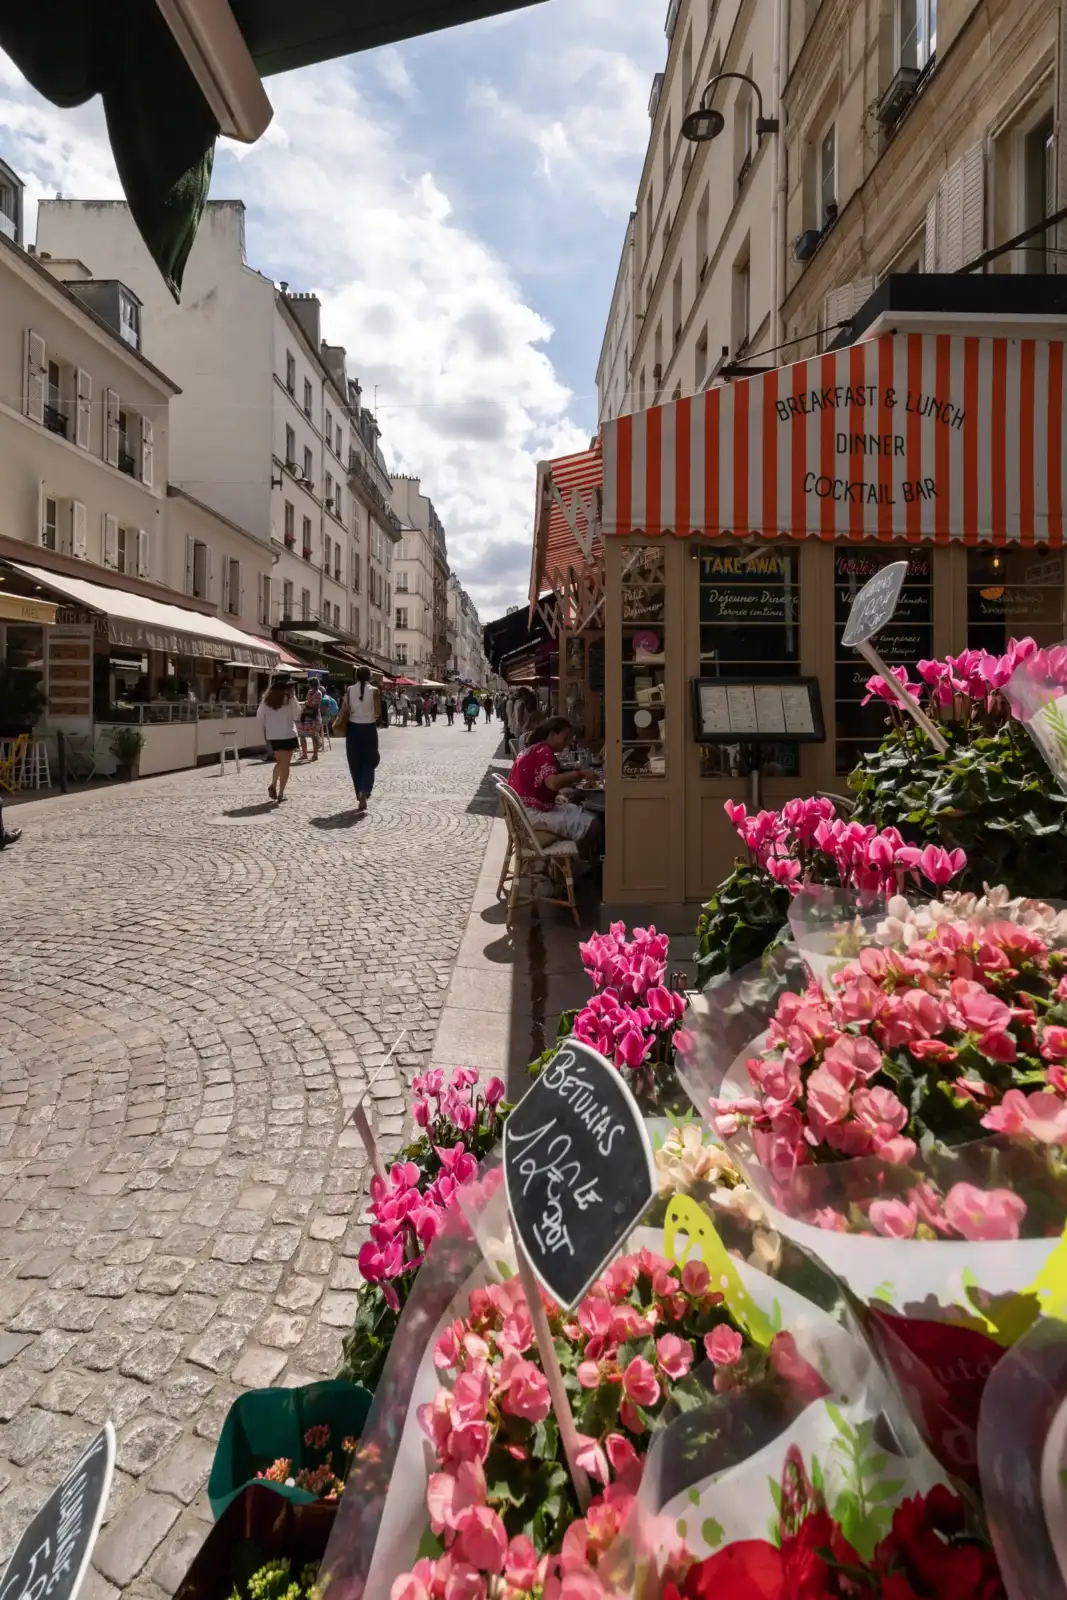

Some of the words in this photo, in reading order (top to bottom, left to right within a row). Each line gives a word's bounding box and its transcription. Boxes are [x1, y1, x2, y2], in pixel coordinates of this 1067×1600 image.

[774, 386, 877, 421] BREAKFAST
[884, 388, 898, 408] &
[905, 391, 966, 430] LUNCH
[836, 433, 905, 456] DINNER
[803, 472, 896, 504] COCKTAIL
[902, 478, 939, 503] BAR
[702, 556, 743, 575] TAKE
[746, 556, 786, 576] AWAY
